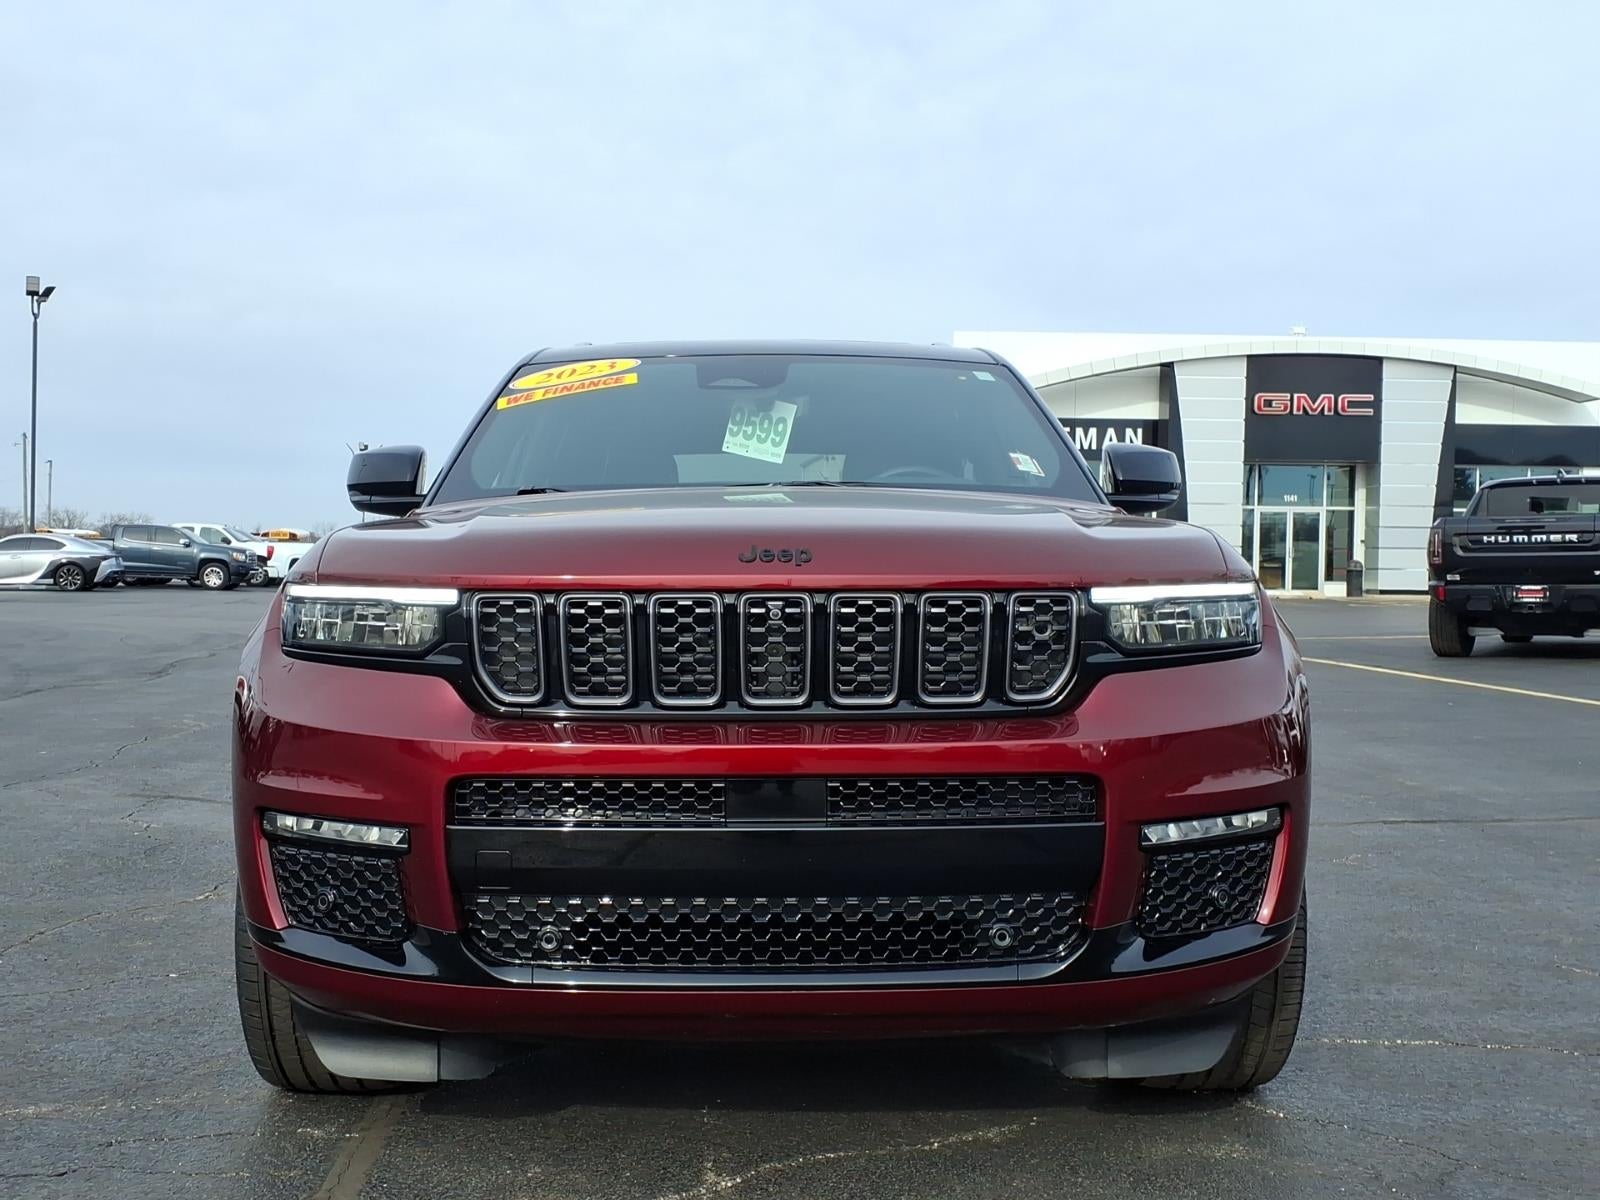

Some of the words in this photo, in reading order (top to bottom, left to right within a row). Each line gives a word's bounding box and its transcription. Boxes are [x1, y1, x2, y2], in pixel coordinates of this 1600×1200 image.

[535, 361, 617, 385] 2023
[506, 391, 536, 406] WE
[541, 377, 626, 398] FINANCE
[1253, 393, 1375, 416] GMC
[728, 407, 788, 448] 9599
[1283, 494, 1298, 503] 1141
[1482, 533, 1579, 544] HUMMER
[738, 544, 813, 567] Jeep
